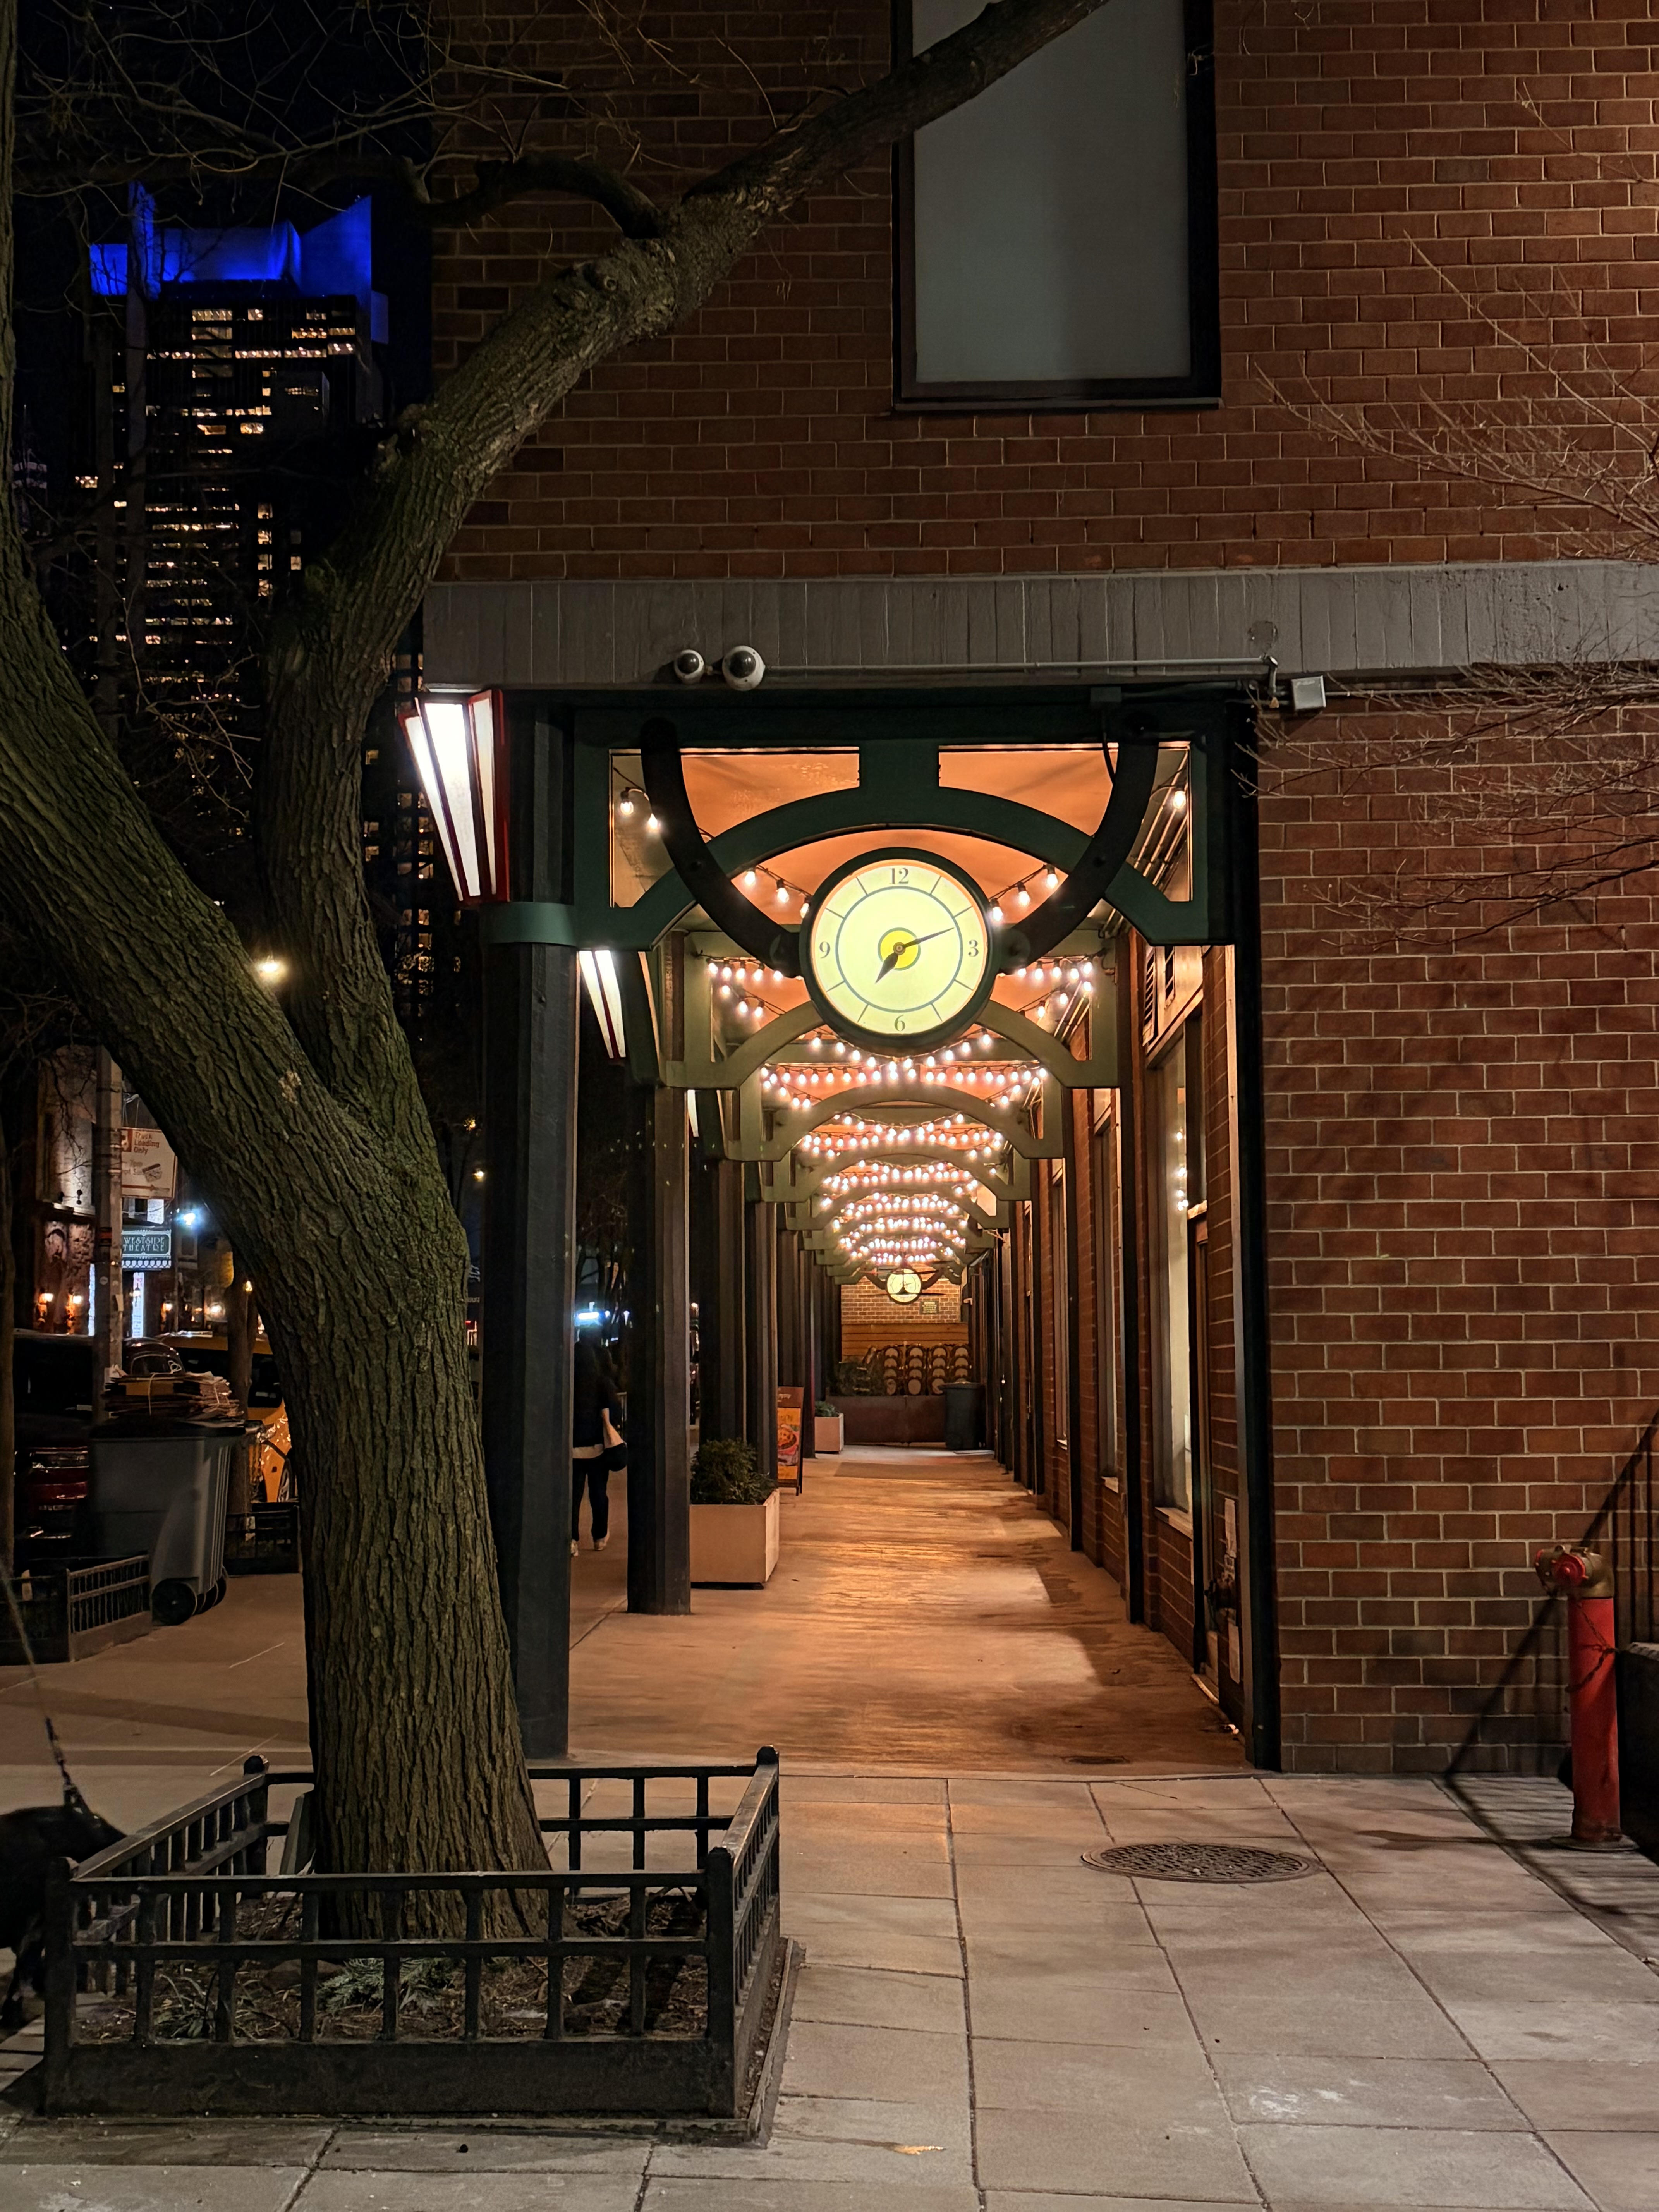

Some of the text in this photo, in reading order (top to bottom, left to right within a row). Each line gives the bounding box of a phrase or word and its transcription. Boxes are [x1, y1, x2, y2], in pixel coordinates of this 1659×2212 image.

[889, 867, 909, 885] 12
[819, 941, 831, 959] 9
[968, 939, 979, 957] 3
[894, 1014, 906, 1031] 6
[135, 1132, 152, 1140] Truck
[134, 1139, 160, 1149] Loading
[134, 1147, 148, 1155] Only
[124, 1237, 165, 1245] WESTSIDE
